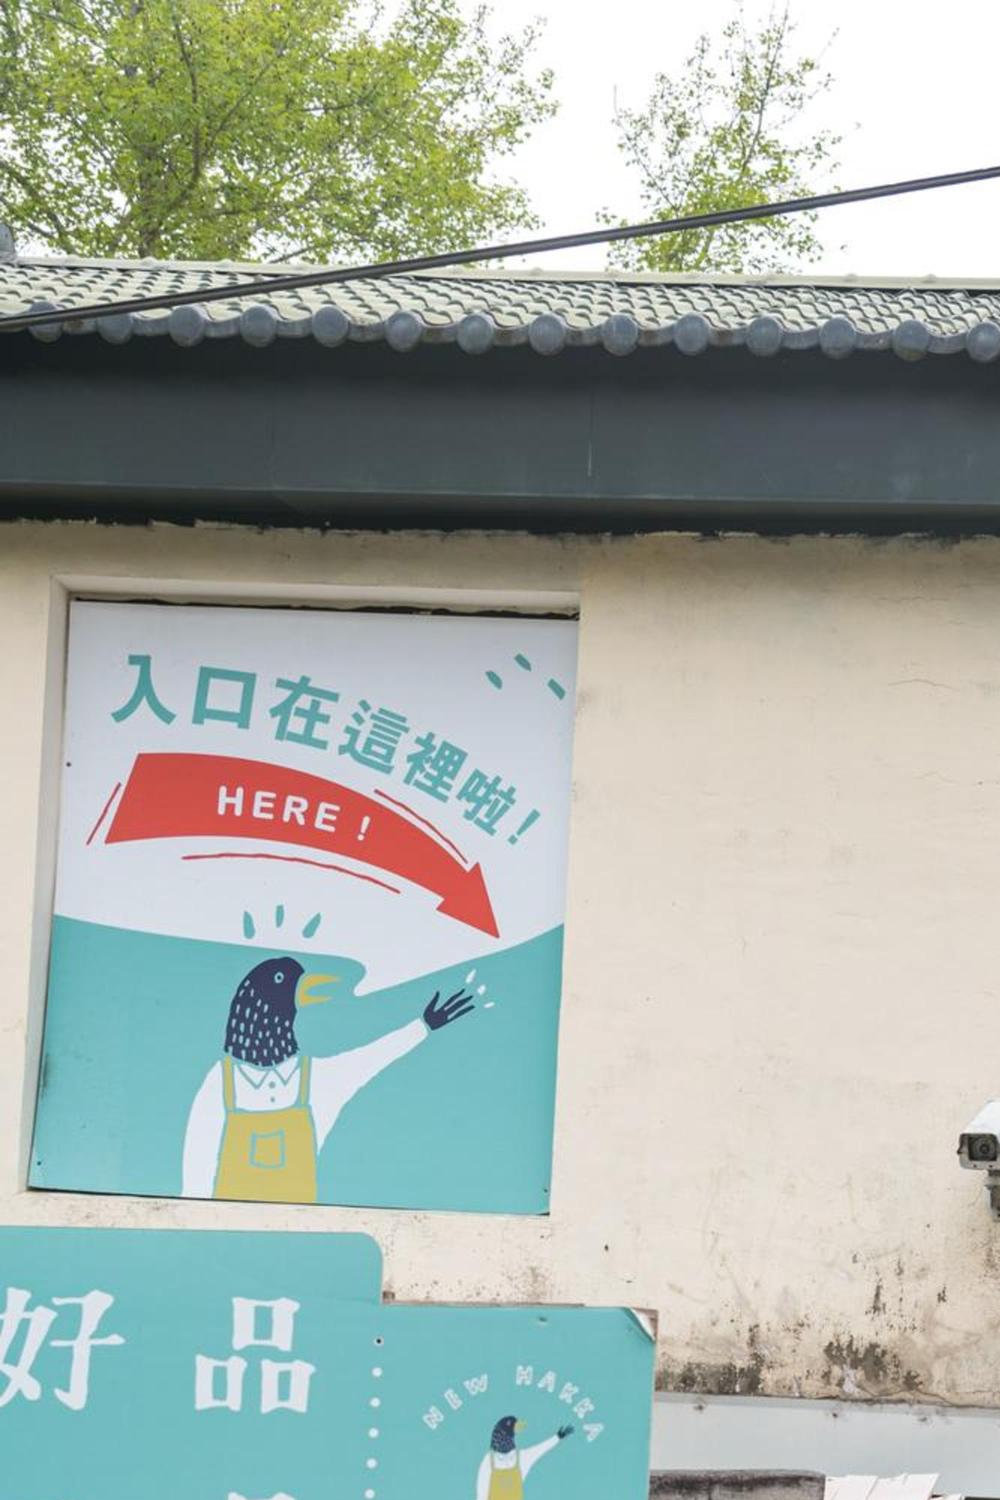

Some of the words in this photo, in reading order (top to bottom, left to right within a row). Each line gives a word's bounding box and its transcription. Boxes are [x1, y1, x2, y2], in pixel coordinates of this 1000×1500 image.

[111, 655, 541, 845] 入口在這裡啦!
[218, 786, 340, 833] HERE
[422, 1374, 488, 1430] NEW
[515, 1365, 605, 1443] HAKKA
